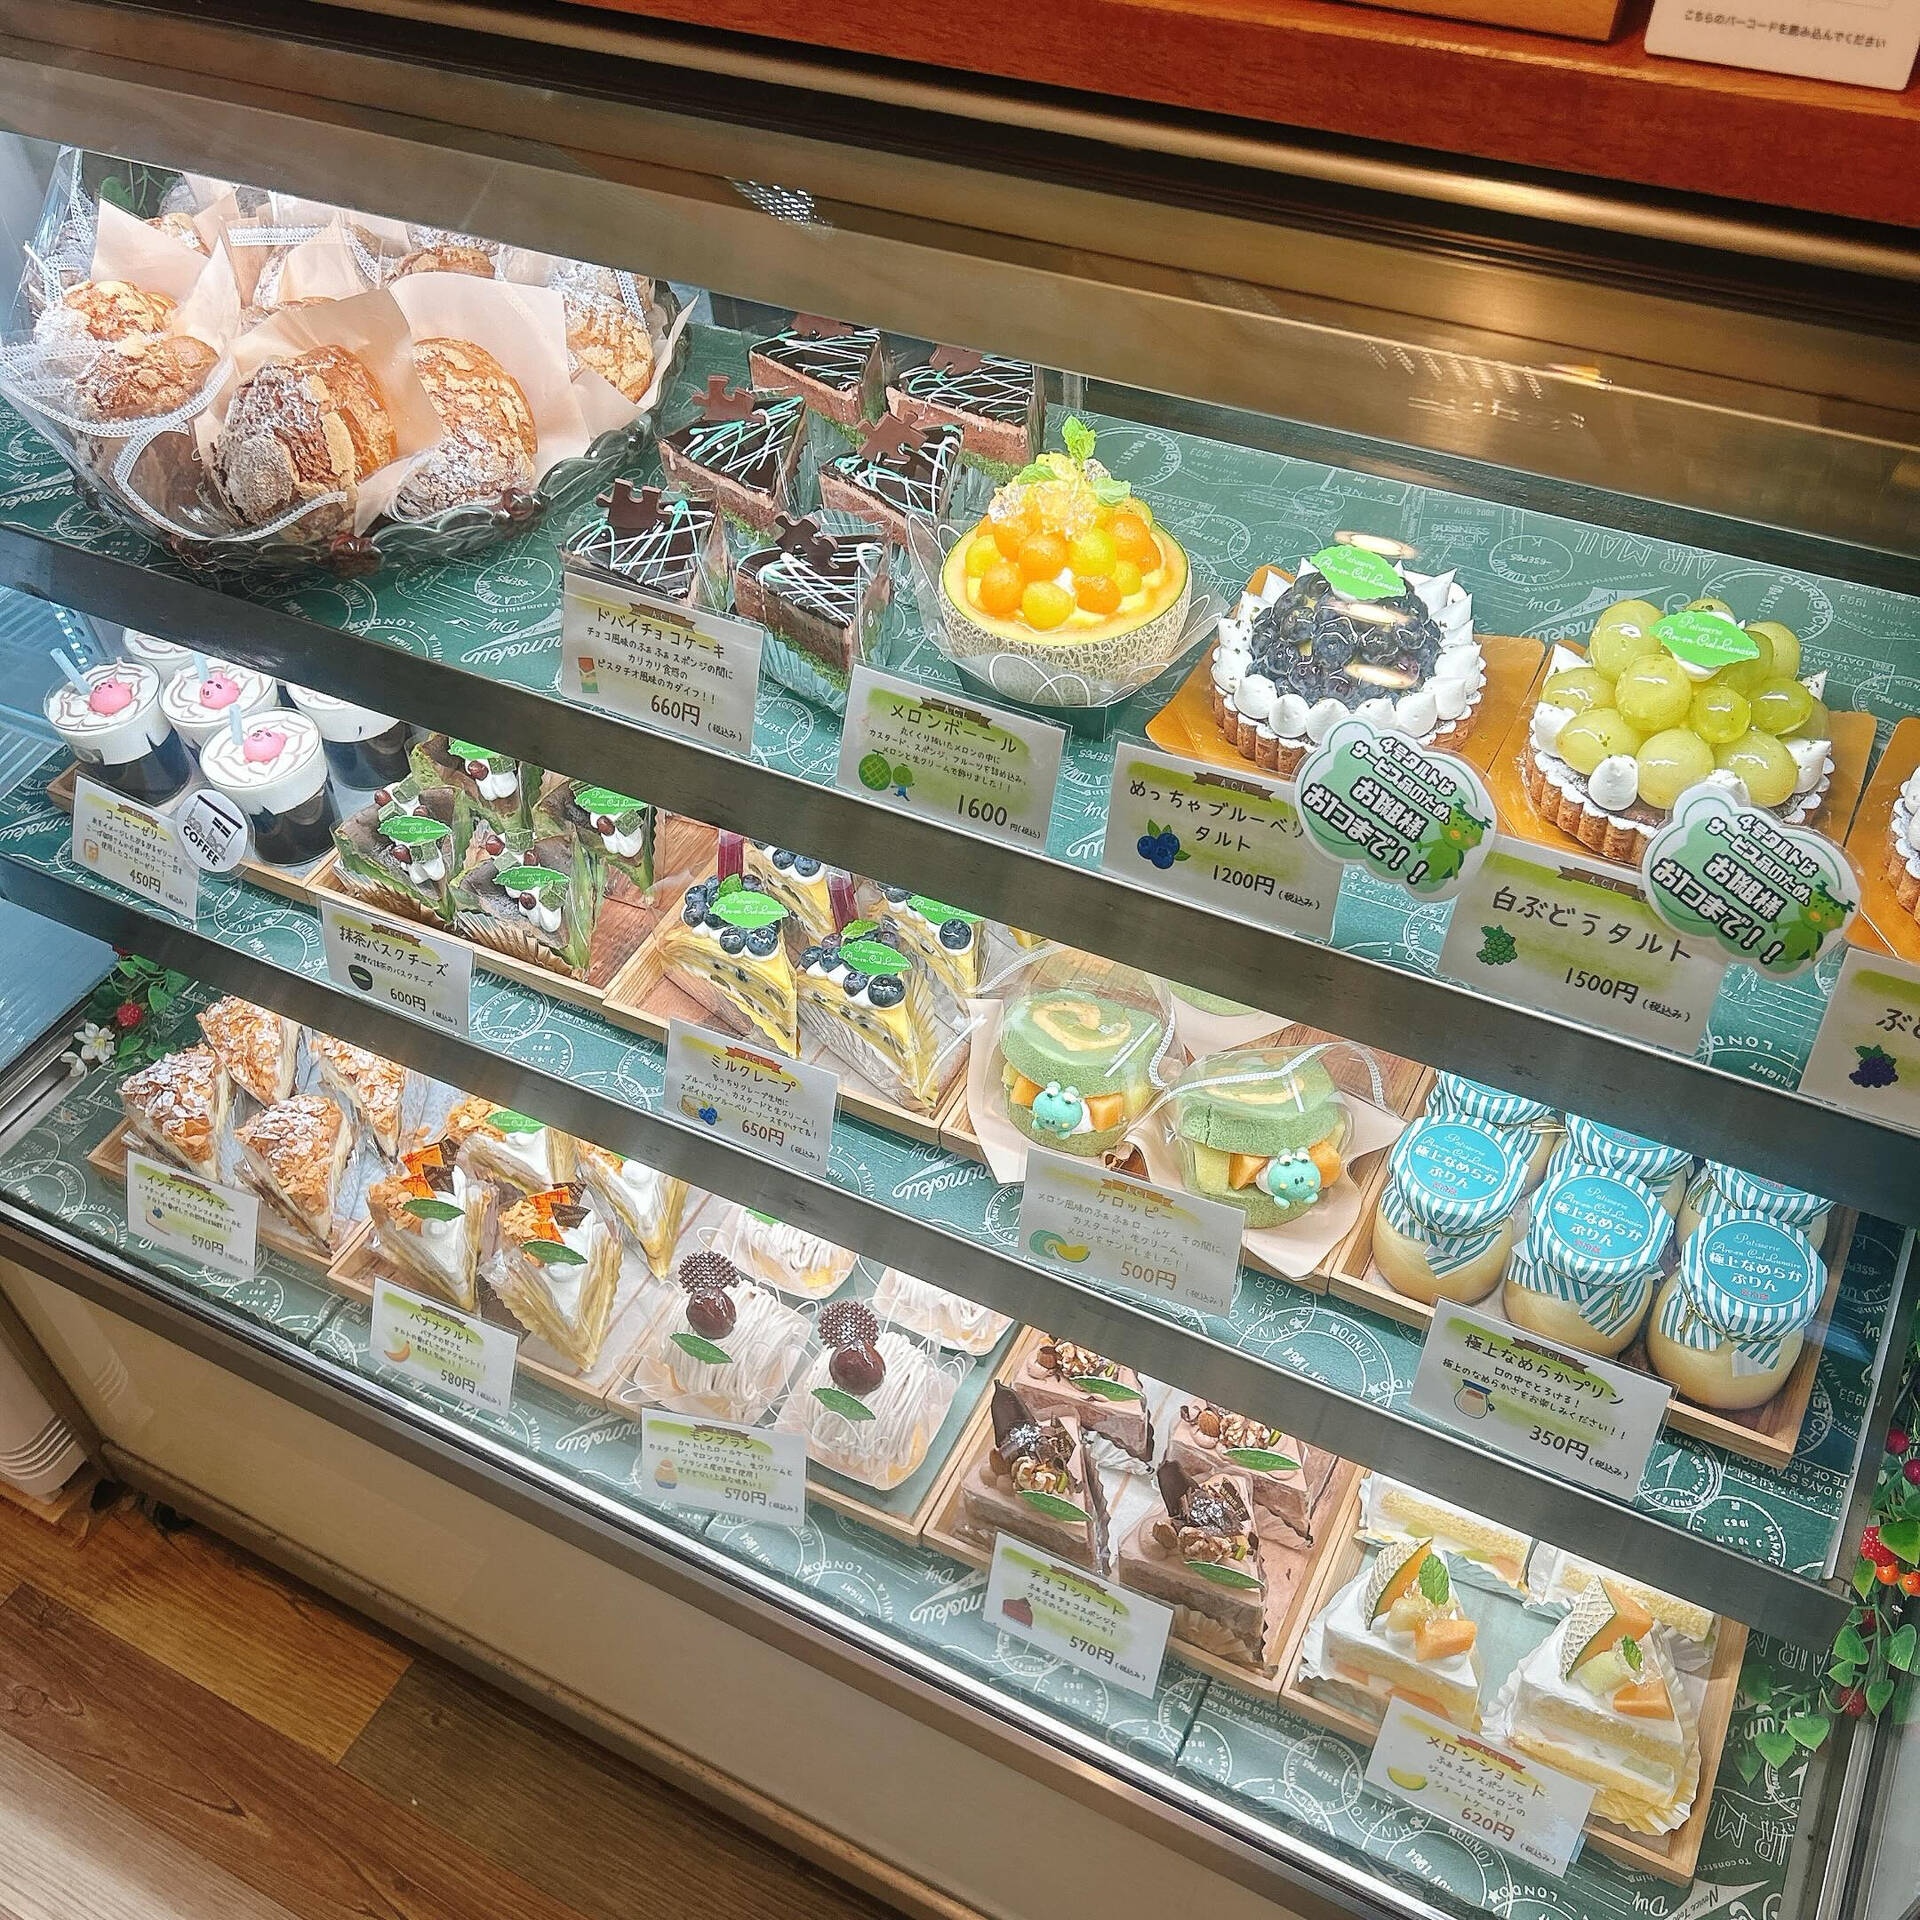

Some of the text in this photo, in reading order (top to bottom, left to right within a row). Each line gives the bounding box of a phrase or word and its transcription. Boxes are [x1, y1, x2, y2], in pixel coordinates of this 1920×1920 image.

[1684, 9, 1888, 49] こちらのバーコードを読み込んでください
[1573, 528, 1718, 581] AIR MAIL
[1524, 592, 1564, 613] Diy
[483, 617, 520, 635] Diy
[596, 608, 727, 660] ドバイチョコケーキ
[627, 653, 688, 681] カリカリ食感の
[650, 694, 743, 743] 660円 (税込み)
[900, 725, 1001, 765] 丸くくり抜いたメロンの中に
[1349, 740, 1452, 826] サービス品のため、
[1379, 736, 1457, 798] 4号タルトは
[106, 808, 168, 843] コーヒーゼリー
[957, 794, 1008, 827] 1600
[182, 824, 221, 867] COFFEE
[1195, 825, 1251, 853] タルト
[1737, 813, 1819, 879] 4号タルトは
[1705, 815, 1813, 907] サービス品のため、
[129, 868, 162, 895] 450円
[1213, 863, 1320, 911] 1200円 (税込み)
[1491, 885, 1693, 963] 白ぶどうタルト
[338, 925, 450, 977] 抹茶バスクチーズ
[390, 988, 427, 1012] 600円
[1564, 967, 1691, 1024] 1500円 (税込み)
[711, 1054, 798, 1094] ミルクレープ
[741, 1118, 786, 1148] 650円
[908, 1143, 942, 1163] Diy
[1413, 1143, 1498, 1187] 極上なめらか
[147, 1174, 235, 1212] インディアンサマー
[1427, 1164, 1469, 1190] ぷりん
[1096, 1190, 1174, 1222] ケロッピー
[1553, 1199, 1643, 1243] 極上なめらか
[191, 1233, 225, 1257] 570円
[1570, 1222, 1613, 1248] ぷりん
[1120, 1260, 1178, 1292] 500円
[1708, 1251, 1803, 1283] 極上なめらか
[1731, 1272, 1777, 1293] ぷりん
[410, 1312, 474, 1345] バナナタルト
[1328, 1321, 1378, 1364] LONDON
[439, 1368, 476, 1395] 580円
[1464, 1332, 1625, 1405] 極上なめらかプリン
[1494, 1366, 1581, 1410] 口の中でとろける！
[690, 1430, 754, 1451] モンブラン
[1528, 1424, 1590, 1463] 350円
[724, 1486, 768, 1508] 570円
[1030, 1567, 1124, 1617] チョコショート
[1069, 1635, 1115, 1666] 570円
[1426, 1736, 1546, 1799] メロンショート
[1461, 1806, 1516, 1843] 620円
[1631, 1890, 1669, 1917] Diy
